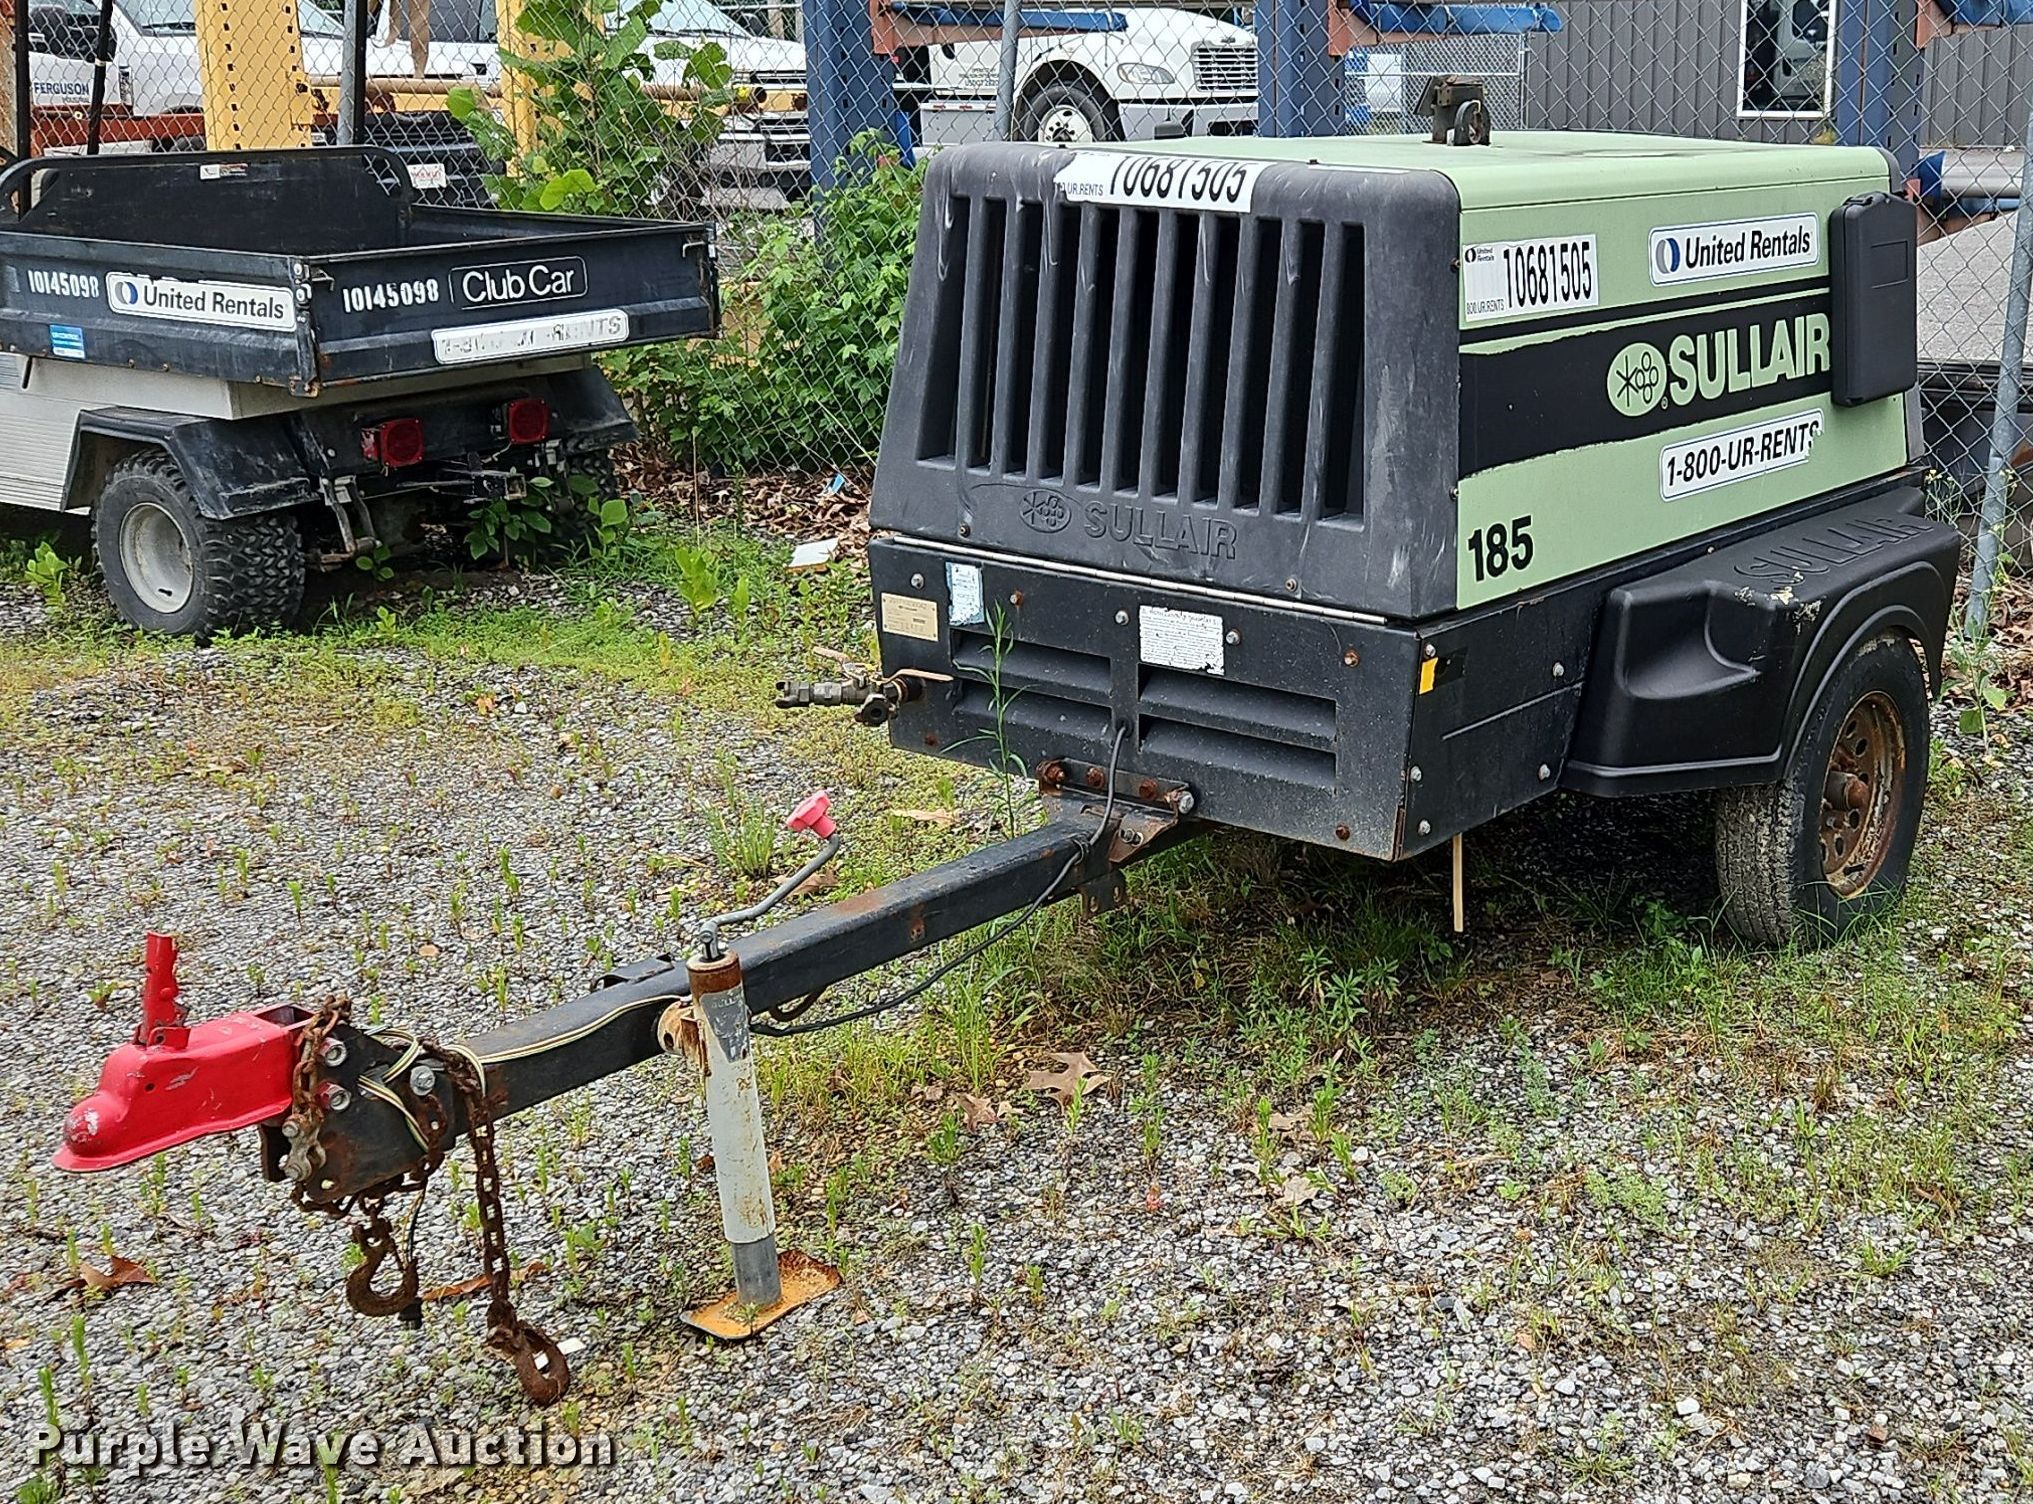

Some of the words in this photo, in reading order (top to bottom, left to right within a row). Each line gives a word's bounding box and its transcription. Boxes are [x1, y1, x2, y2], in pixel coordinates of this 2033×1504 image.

[33, 82, 90, 95] FERGUSON
[1110, 156, 1256, 203] 10681505
[1685, 231, 1745, 269] United
[1750, 225, 1811, 261] Rentals
[28, 270, 100, 298] 10145098
[343, 279, 439, 313] 10145098
[462, 271, 526, 303] Club
[529, 264, 575, 296] Car
[1503, 241, 1592, 309] 10681505
[143, 285, 206, 312] United
[212, 292, 284, 319] Rentals
[1669, 312, 1831, 407] SULLAIR
[1084, 501, 1238, 560] SULLAIR
[1467, 515, 1534, 582] 185
